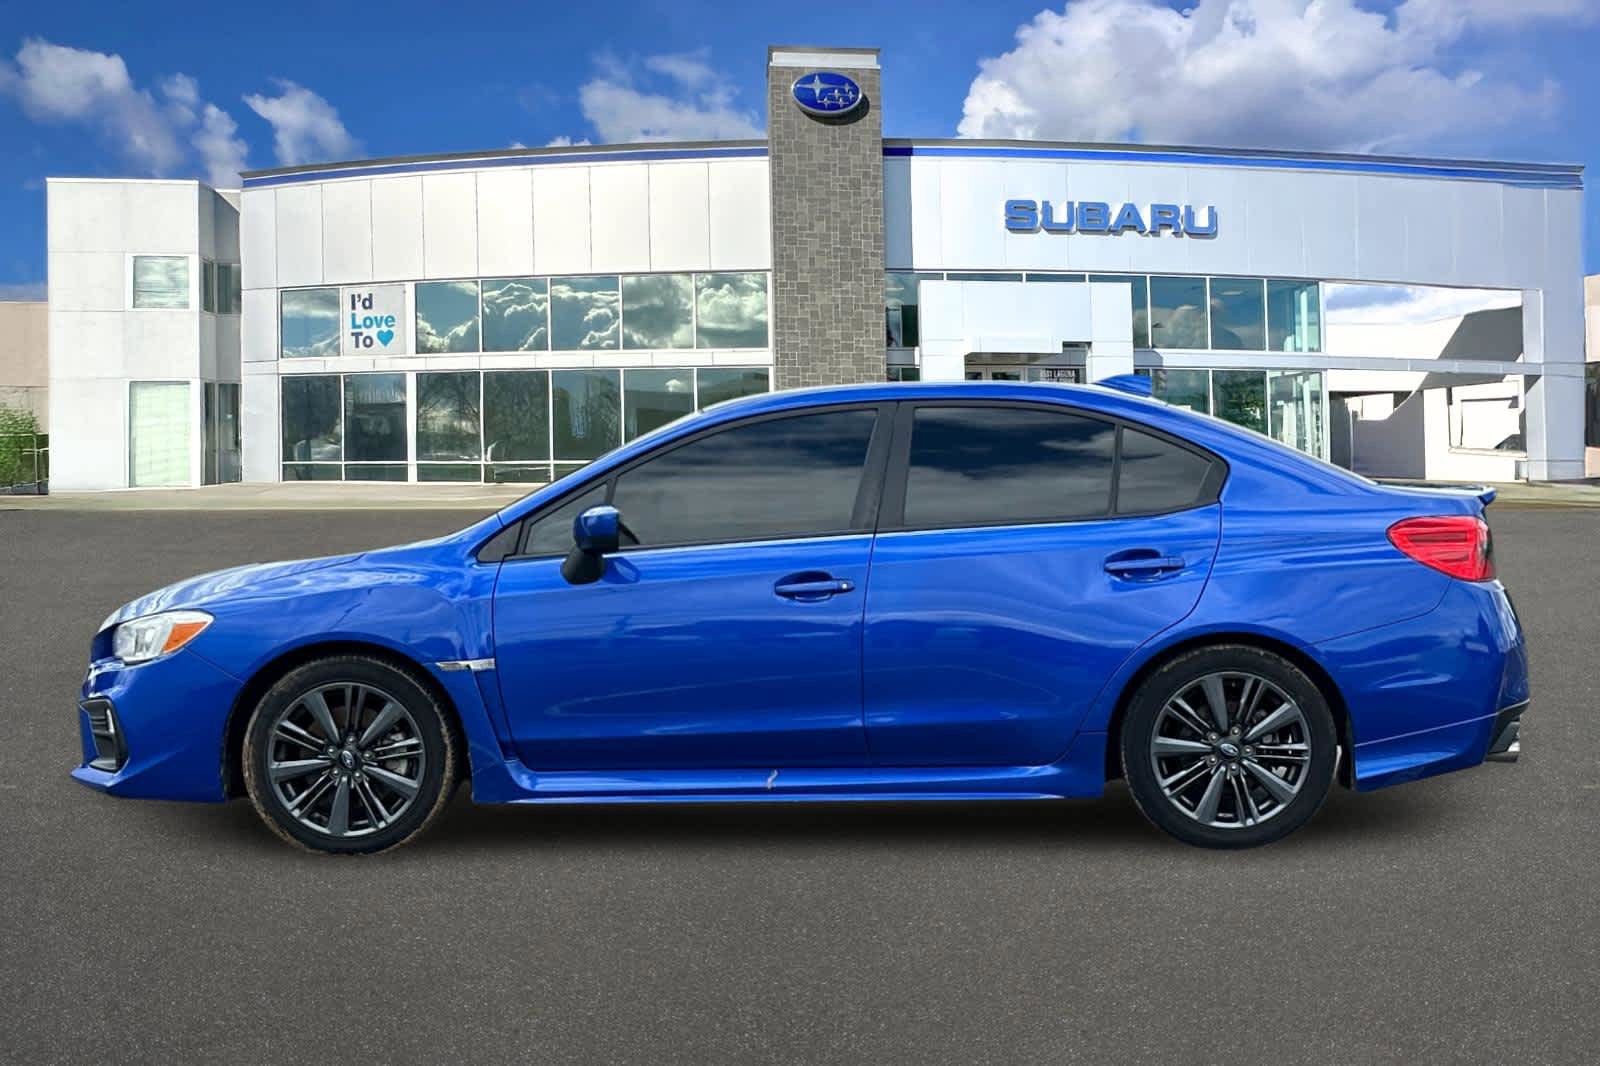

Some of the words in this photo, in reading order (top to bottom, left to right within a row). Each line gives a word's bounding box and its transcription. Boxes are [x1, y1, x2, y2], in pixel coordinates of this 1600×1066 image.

[1005, 200, 1217, 238] SUBARU
[351, 293, 373, 310] I’d
[351, 312, 396, 329] Love
[351, 331, 373, 348] To
